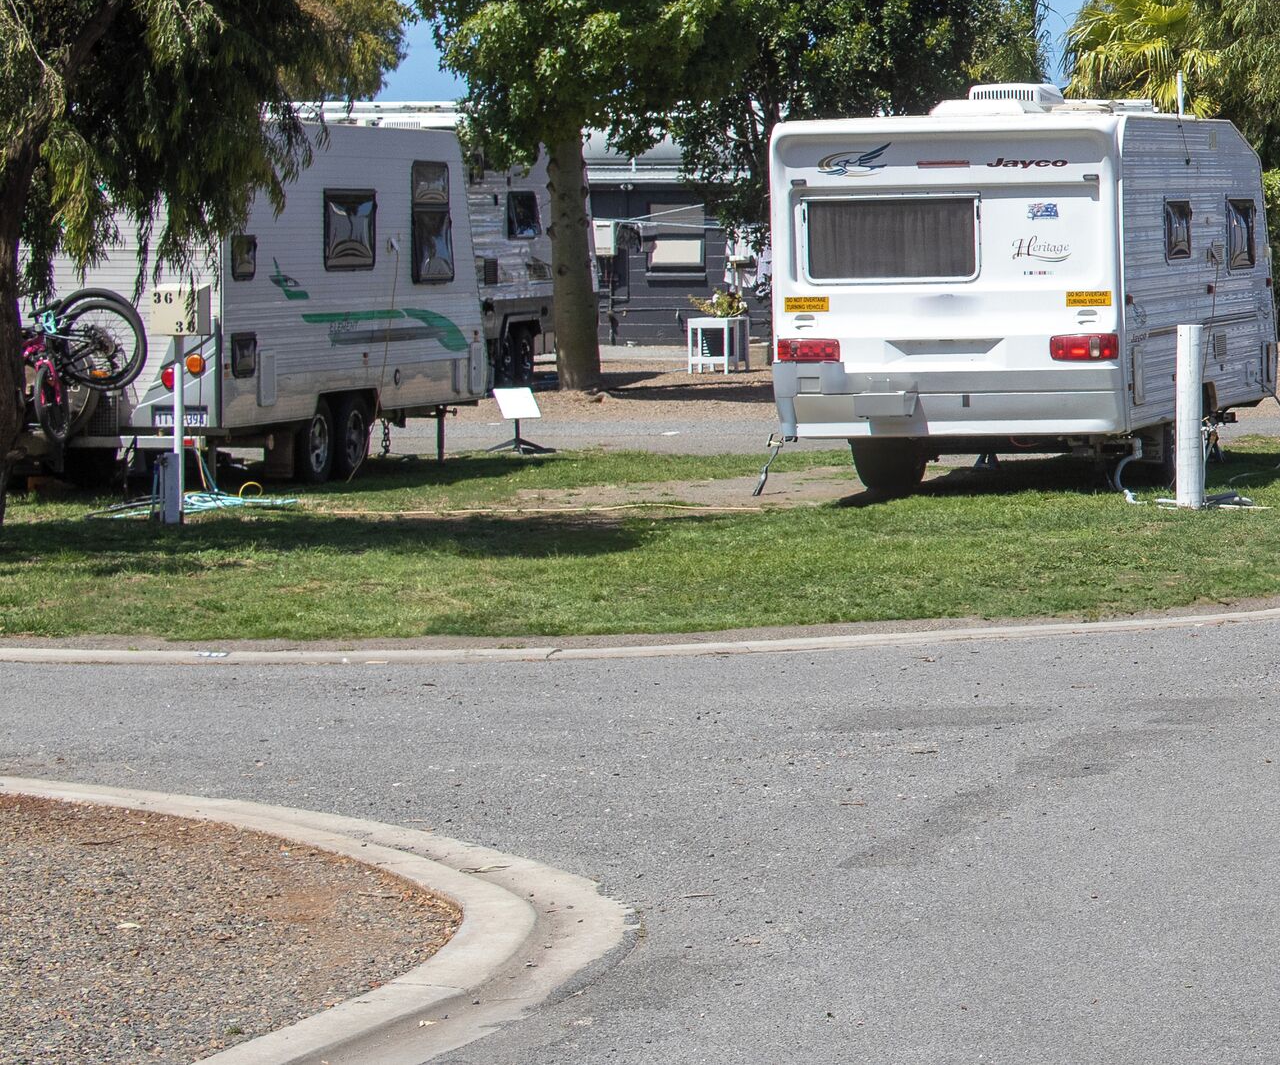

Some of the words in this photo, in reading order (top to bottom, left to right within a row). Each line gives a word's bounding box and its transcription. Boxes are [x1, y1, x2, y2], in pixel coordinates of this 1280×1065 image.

[987, 157, 1069, 169] Jayco
[1011, 235, 1070, 258] Heritage
[153, 292, 173, 304] 36
